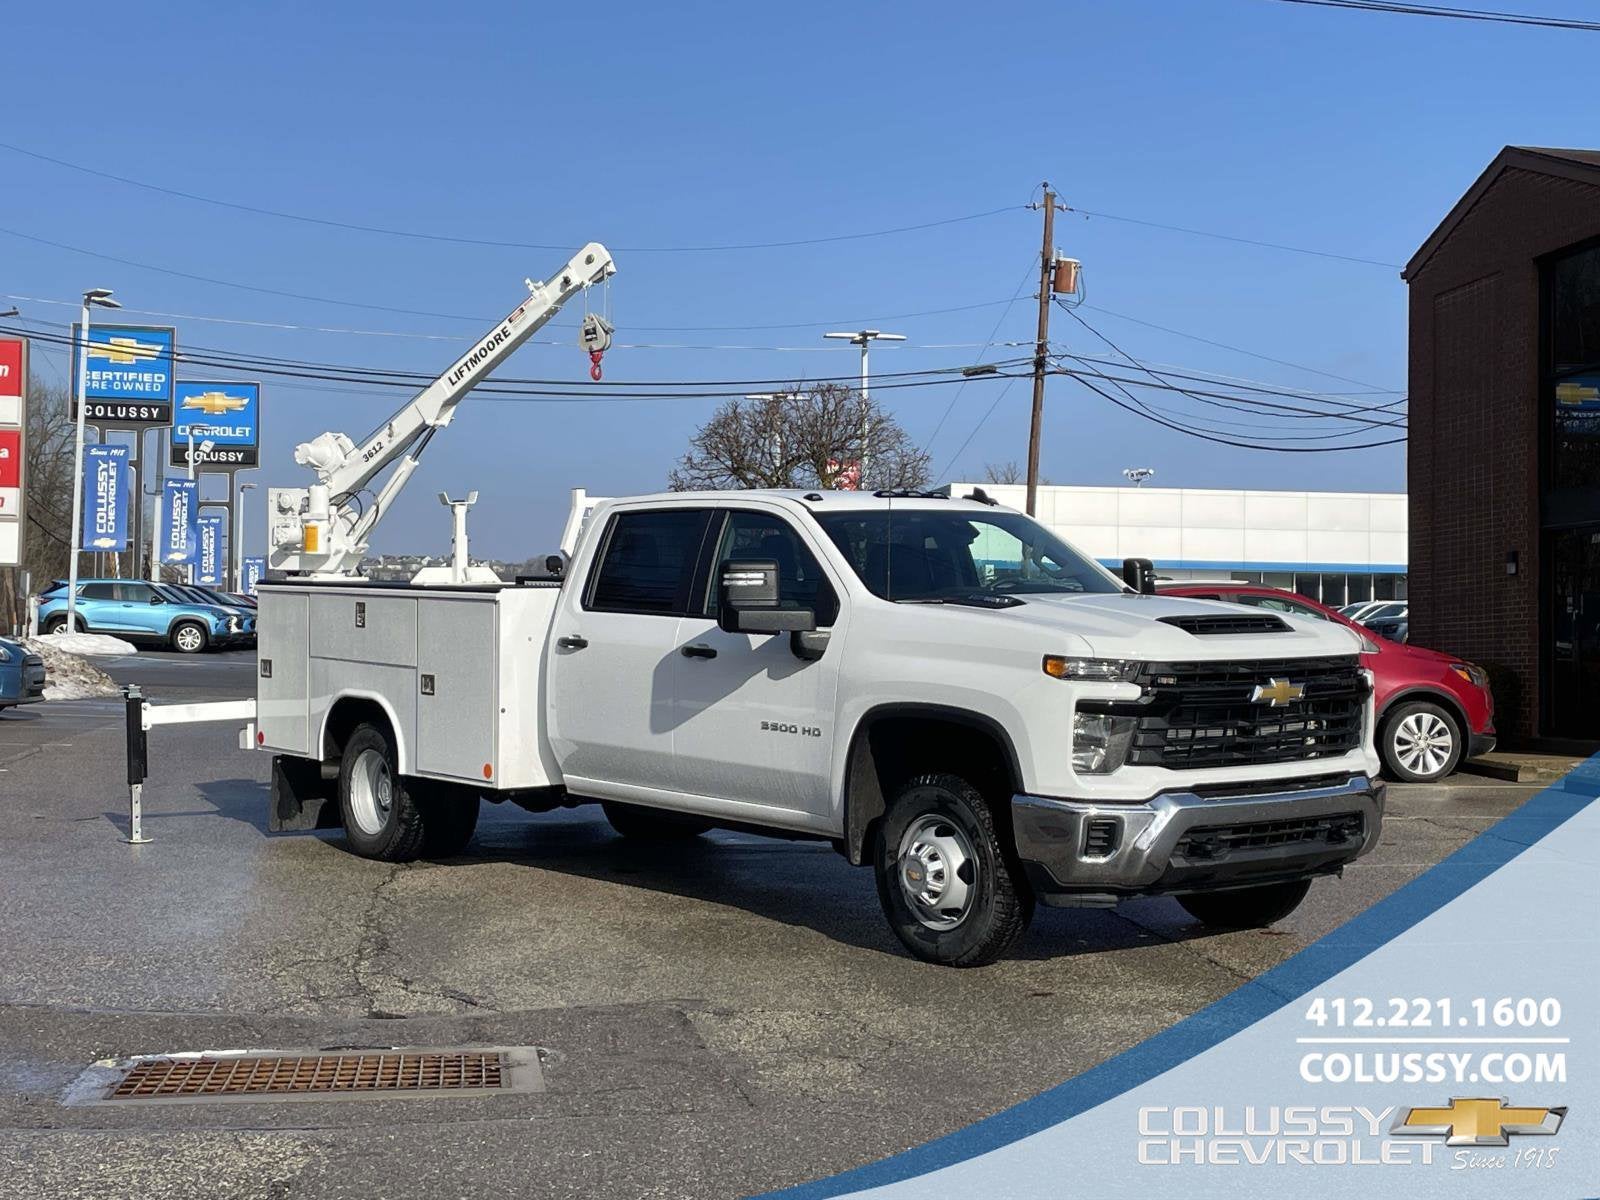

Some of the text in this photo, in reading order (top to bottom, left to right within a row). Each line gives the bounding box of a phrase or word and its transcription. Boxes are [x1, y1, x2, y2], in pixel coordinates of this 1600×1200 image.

[447, 327, 511, 387] LIFTMOORE
[84, 405, 159, 418] COLUSSY
[362, 441, 384, 463] 3612
[96, 459, 108, 534] COLUSSY
[107, 460, 117, 533] CHEVROLET
[171, 490, 182, 549] COLUSSY
[180, 491, 189, 549] CHEVROLET
[760, 721, 822, 738] 3500 HD
